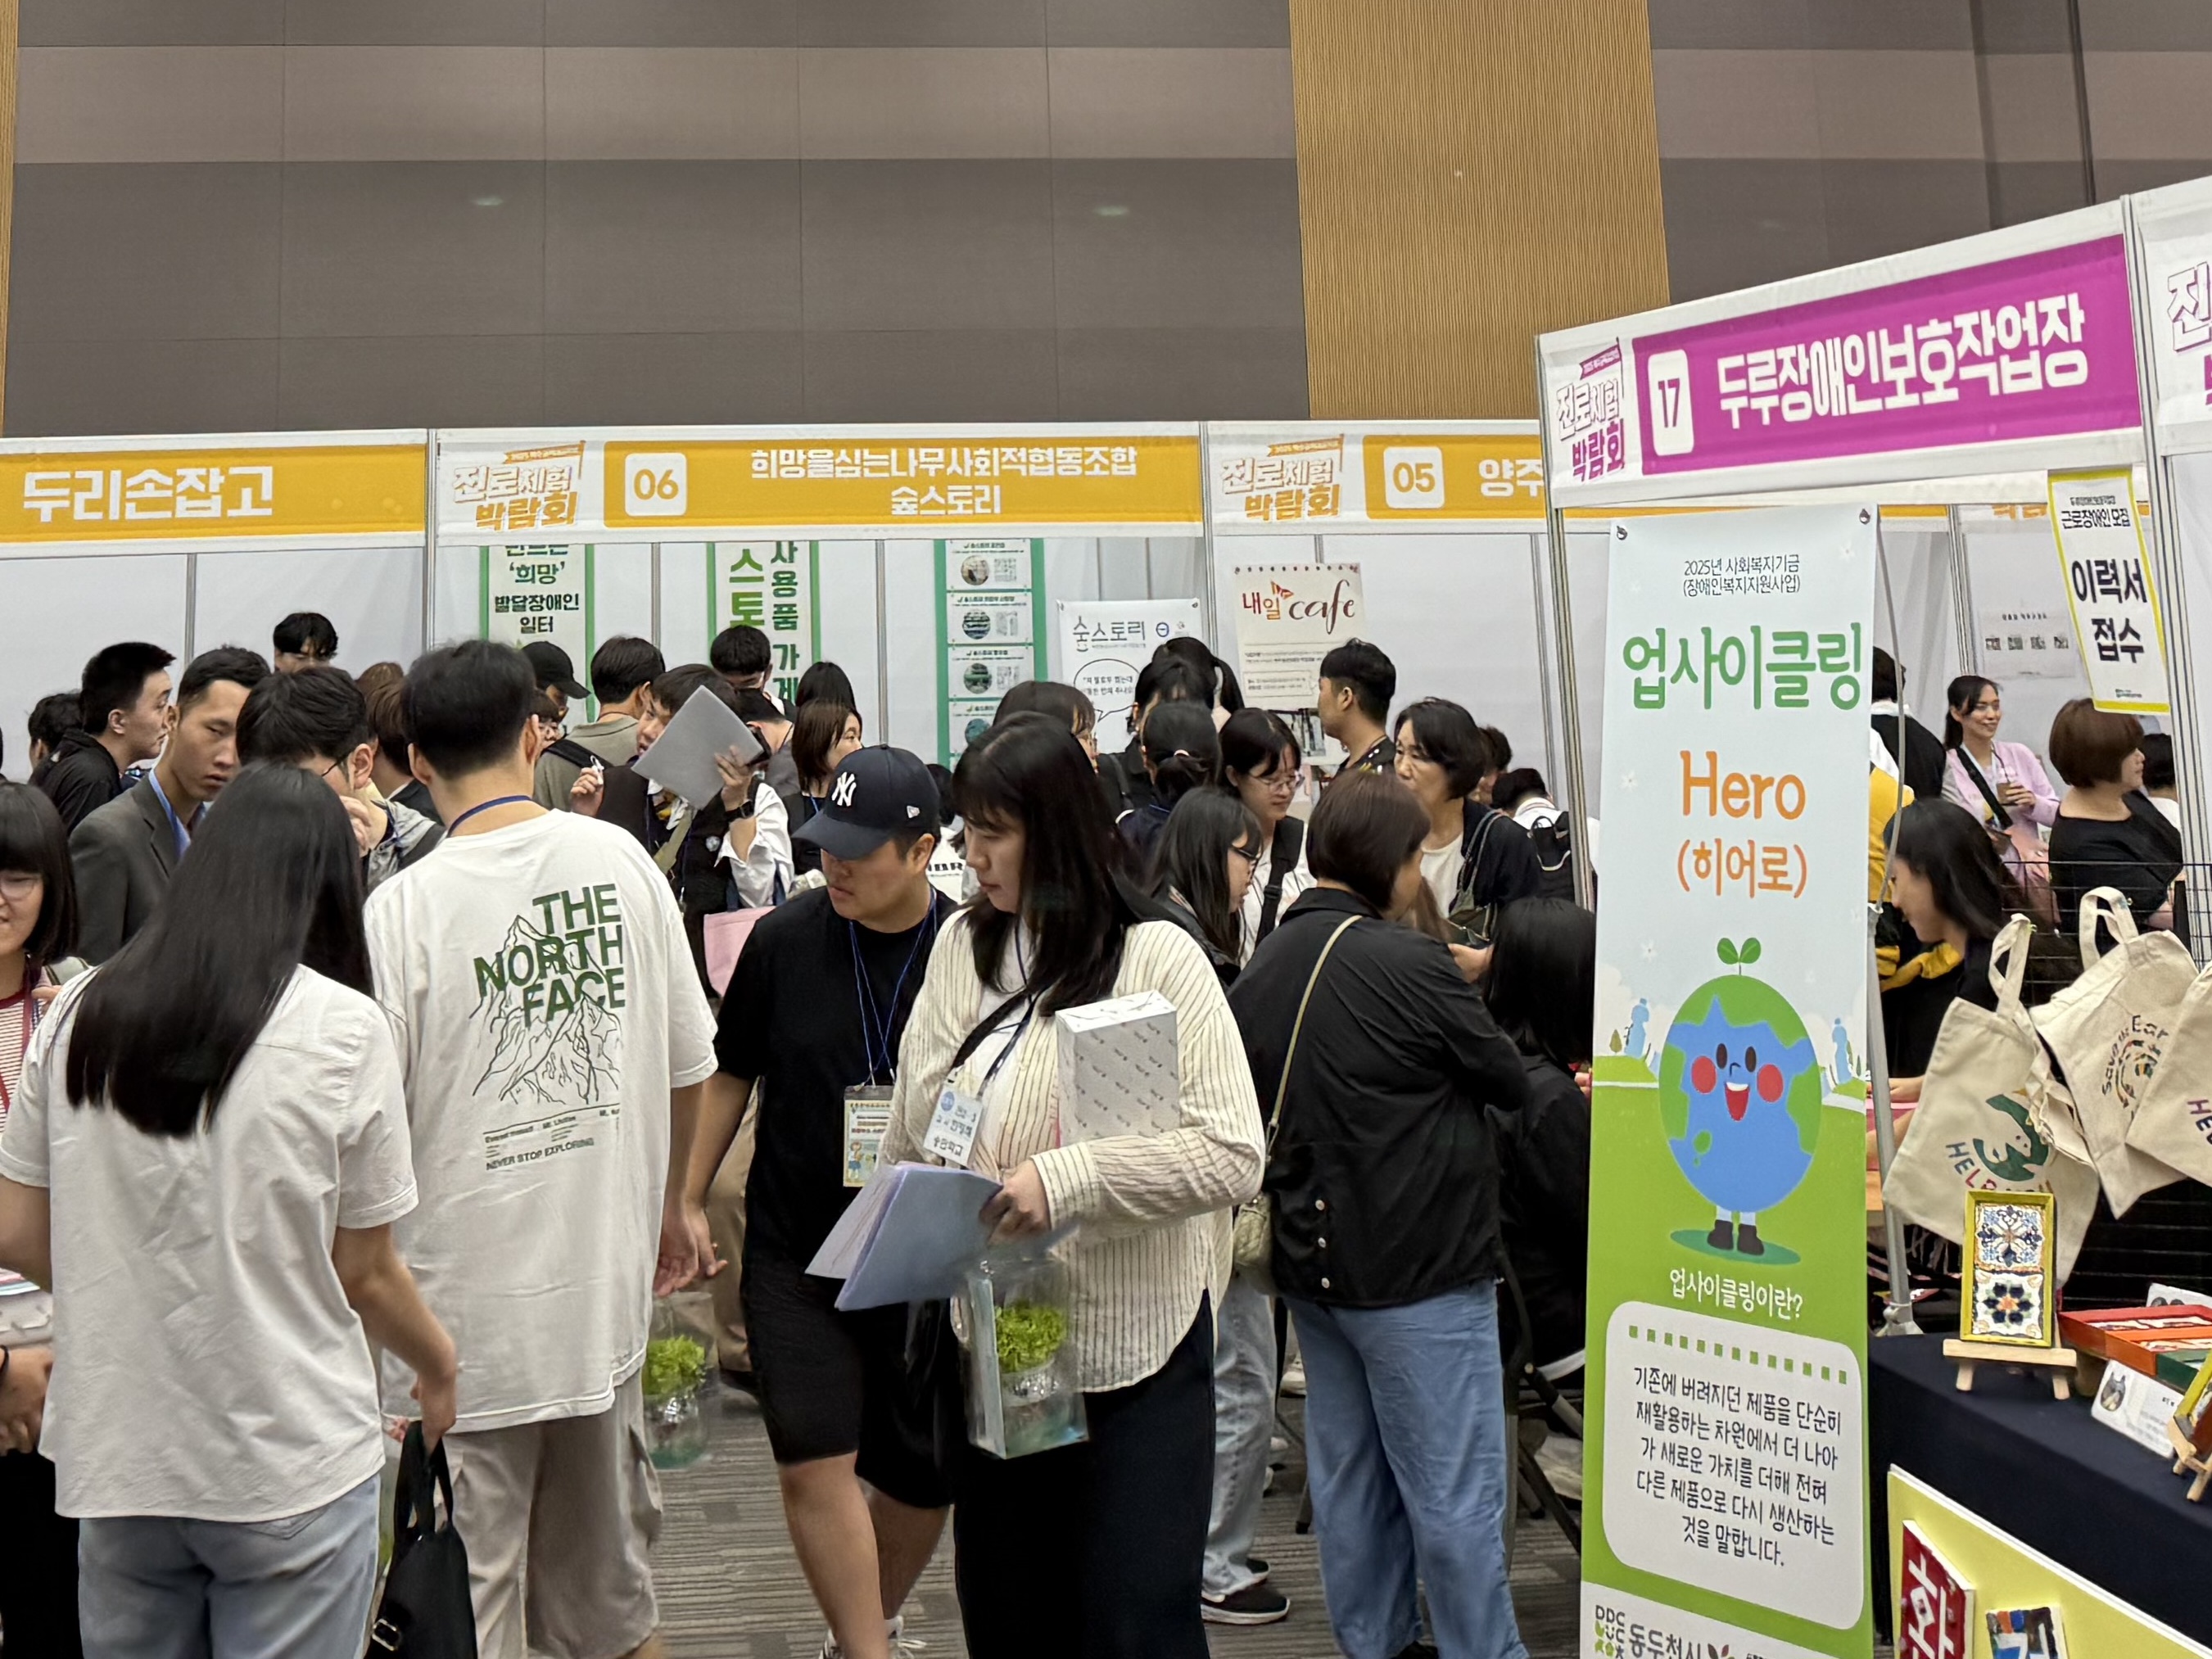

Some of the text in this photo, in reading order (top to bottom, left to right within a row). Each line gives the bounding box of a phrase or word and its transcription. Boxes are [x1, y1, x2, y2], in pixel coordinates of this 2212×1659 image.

[1717, 292, 2088, 428] 두루장애인보호작업장
[1657, 378, 1680, 430] 17
[751, 446, 1138, 479] 희망을심는나무사회적협동조합
[1572, 418, 1625, 482] 박람회
[23, 466, 274, 522] 두리손잡고
[453, 465, 572, 503] 진로체험
[633, 468, 680, 501] 06
[1221, 457, 1332, 495] 진로체험
[1392, 462, 1436, 493] 05
[1478, 459, 1544, 497] 양주
[476, 491, 577, 531] 박람회
[890, 485, 1002, 516] 숲스토리
[1245, 484, 1341, 521] 박람회
[1683, 574, 1801, 597] (장애인복지지원사업)
[1685, 554, 1800, 576] 2025년 사회복지기금
[2071, 558, 2148, 603] 이력서
[495, 594, 579, 613] 발달장애인
[520, 616, 553, 634] 일터
[1242, 579, 1355, 635] 내일 cafe
[2091, 617, 2145, 663] 접수
[1622, 622, 1861, 710] 업사이클링
[1680, 750, 1807, 820] Hero
[1677, 839, 1807, 898] (히어로)
[532, 883, 622, 934] THE
[473, 924, 623, 998] NORTH
[522, 967, 626, 1028] FACE
[486, 1155, 515, 1170] NEVER
[517, 1150, 542, 1163] STOP
[1670, 1268, 1803, 1320] 업사이클링이란?
[1633, 1367, 1841, 1435] 기존에 버려지던 제품을 단순히
[1636, 1401, 1838, 1471] 재활용하는 차원에서 더 나아
[1641, 1437, 1826, 1505] 가 새로운 가치를 더해 전혀
[1636, 1470, 1834, 1546] 다른 제품으로 다시 생산하는
[1682, 1515, 1785, 1566] 것을 말합니다.
[1595, 1604, 1626, 1627] DDC
